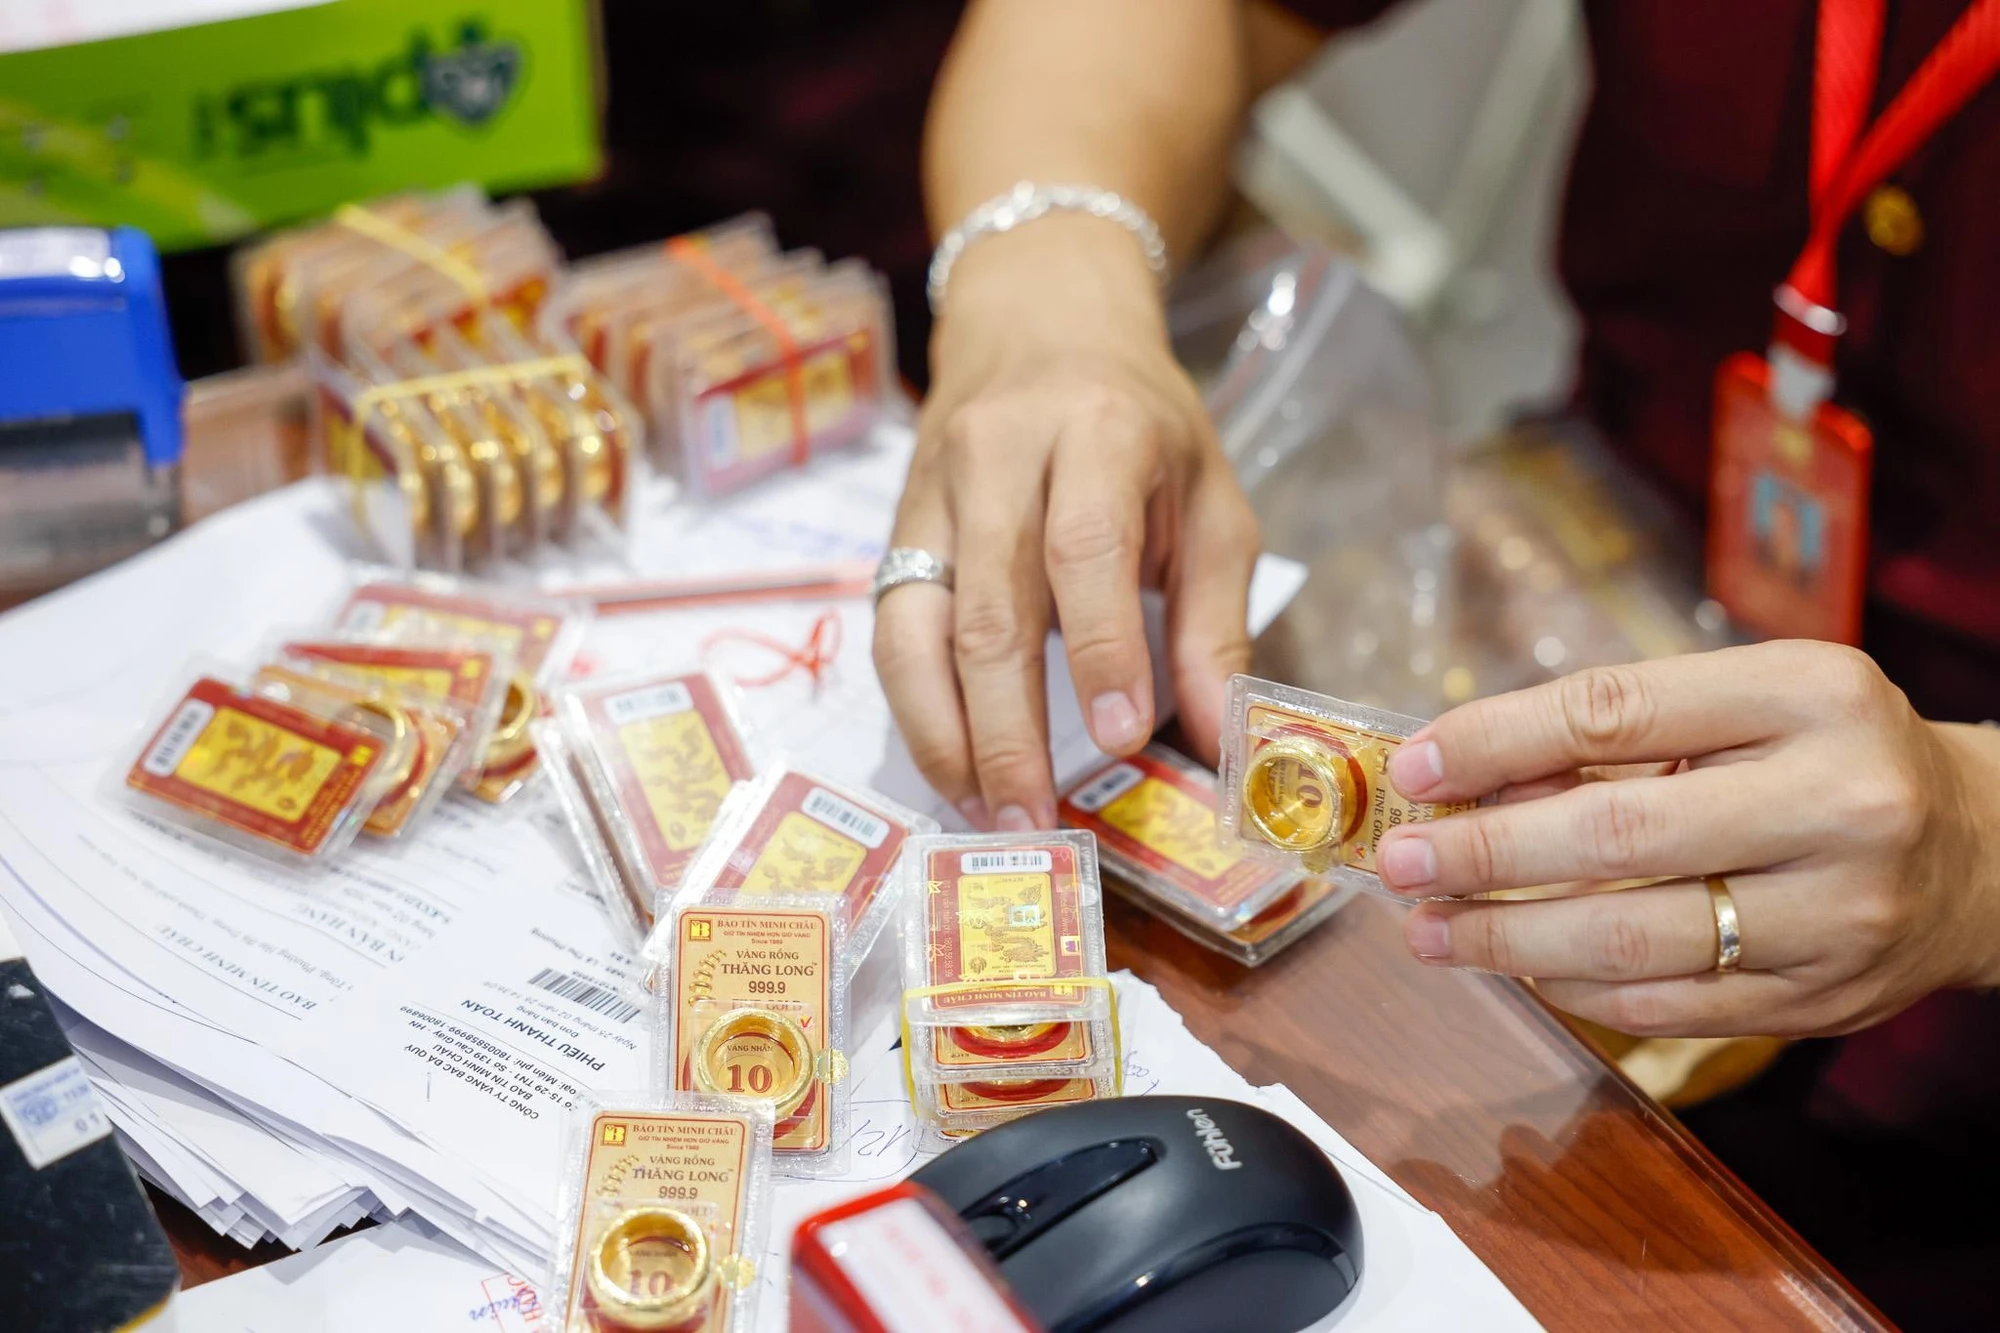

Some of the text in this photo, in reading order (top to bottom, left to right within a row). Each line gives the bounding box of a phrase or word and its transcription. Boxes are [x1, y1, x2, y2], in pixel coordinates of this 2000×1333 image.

[1375, 787, 1385, 817] FINE
[741, 920, 759, 928] TÍN
[760, 921, 786, 930] MINH
[789, 920, 817, 930] CHÂU
[736, 948, 799, 960] VÀNG RỒNG
[721, 962, 771, 976] THĂNG
[748, 981, 786, 994] 999.9
[974, 992, 1002, 1000] MINH
[408, 1020, 427, 1031] HN
[562, 1026, 580, 1039] Đơn
[460, 999, 606, 1072] PHIẾU THANH TOÁN
[473, 1052, 492, 1065] 139
[462, 1060, 492, 1078] MINH
[465, 1075, 494, 1095] VÀNG
[514, 1072, 534, 1088] TN1
[727, 1064, 773, 1094] 10
[494, 1091, 508, 1103] TY
[534, 1084, 563, 1104] 15-29
[509, 1099, 539, 1120] CÔNG
[657, 1125, 675, 1134] TÍN
[677, 1127, 705, 1136] MINH
[650, 1155, 715, 1166] VÀNG RỒNG
[632, 1167, 684, 1181] THĂNG
[659, 1186, 698, 1200] 999.9
